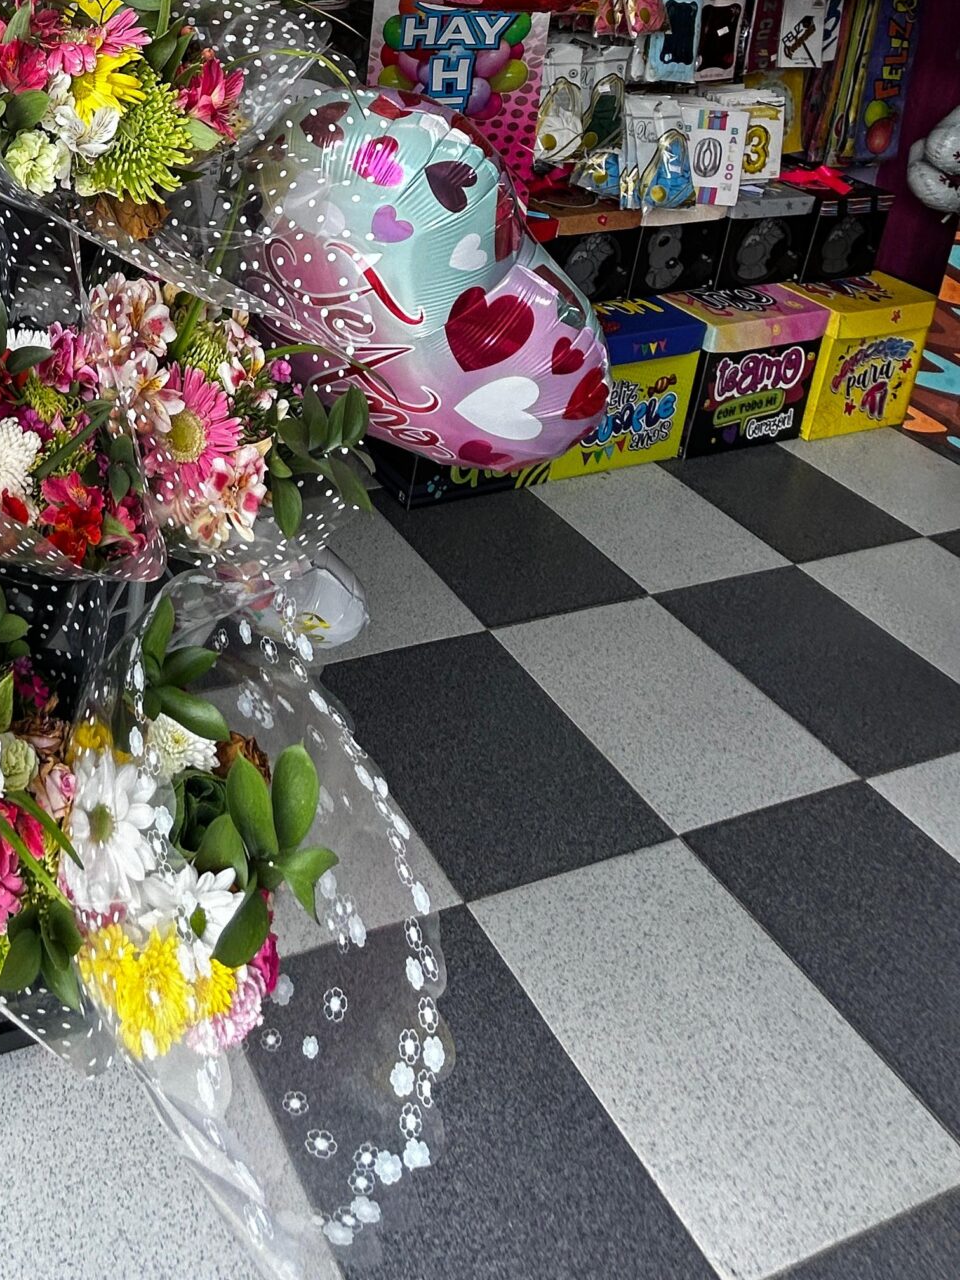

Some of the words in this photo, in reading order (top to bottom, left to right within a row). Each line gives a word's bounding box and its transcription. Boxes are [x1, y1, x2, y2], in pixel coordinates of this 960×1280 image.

[400, 14, 514, 49] HAY
[873, 18, 913, 100] FELIZ
[609, 380, 639, 408] eliz
[845, 359, 894, 398] para
